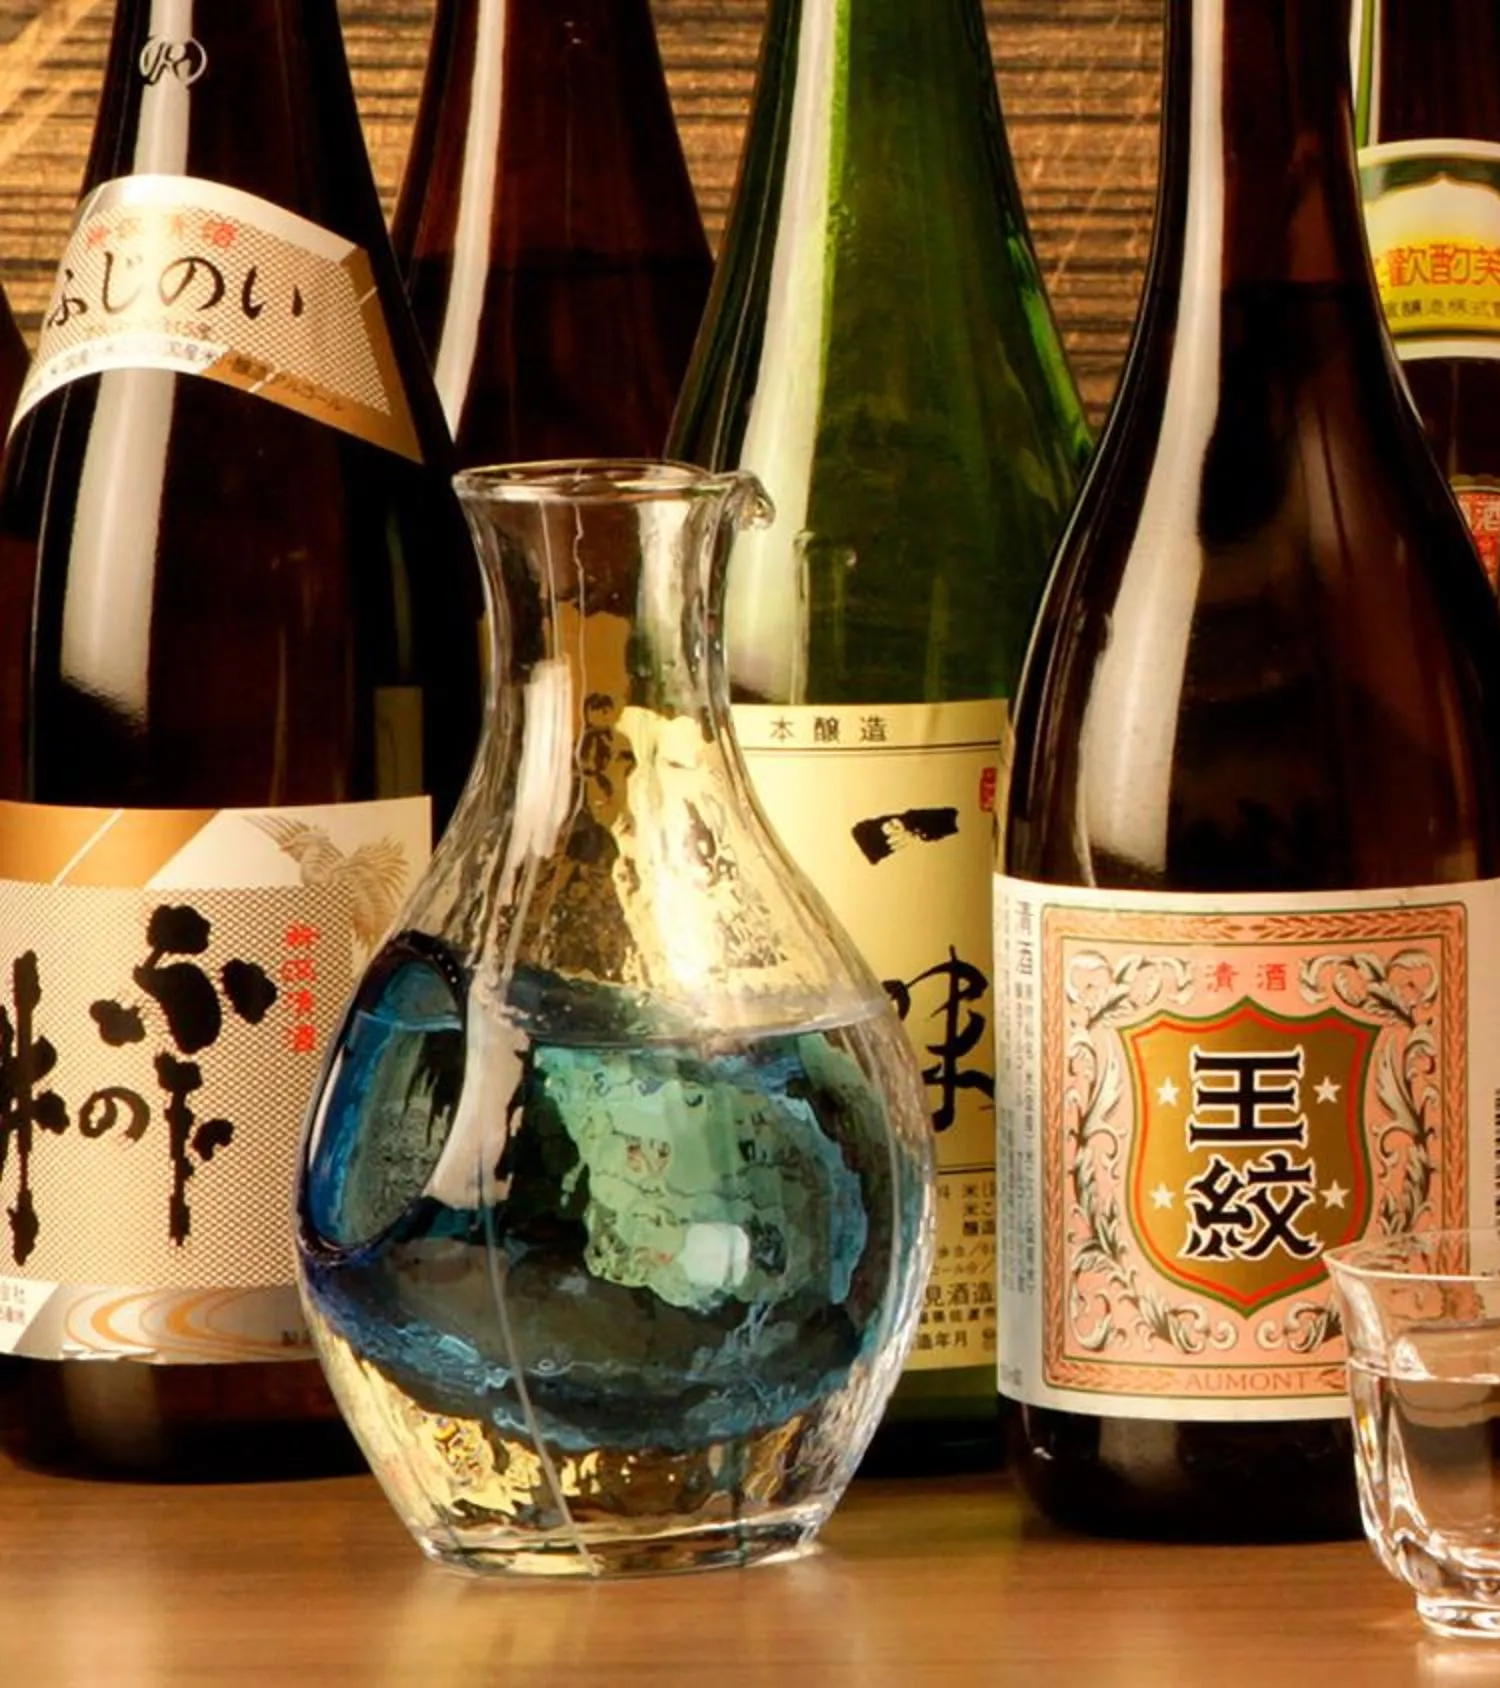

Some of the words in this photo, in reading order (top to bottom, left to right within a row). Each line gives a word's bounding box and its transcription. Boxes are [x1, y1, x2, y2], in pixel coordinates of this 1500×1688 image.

[46, 251, 304, 327] ふじのい
[768, 714, 888, 742] 本醸造
[1206, 962, 1289, 993] 清酒
[1181, 1044, 1322, 1262] 王紋
[1185, 1368, 1315, 1392] AUMONT
